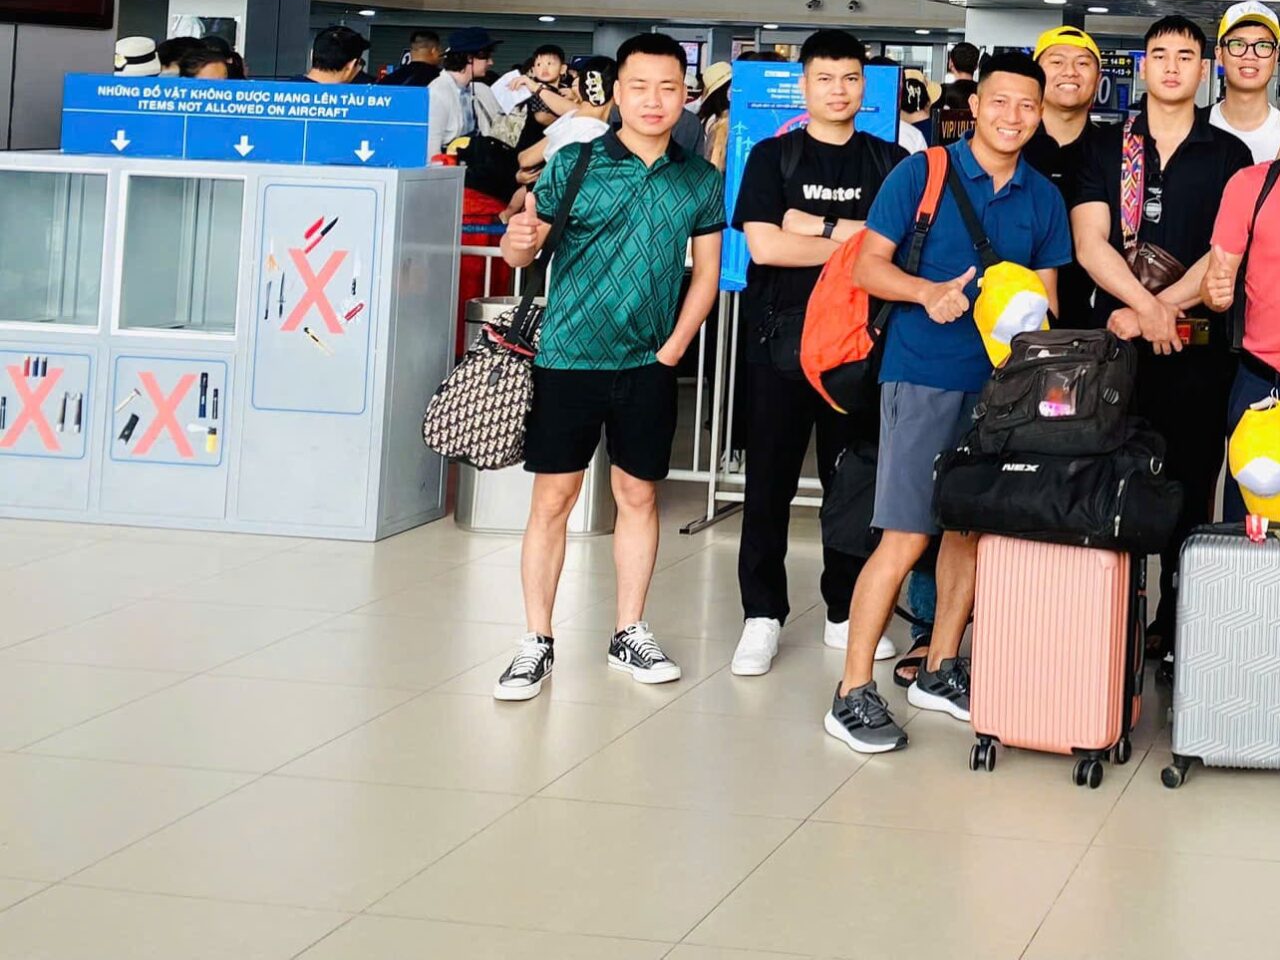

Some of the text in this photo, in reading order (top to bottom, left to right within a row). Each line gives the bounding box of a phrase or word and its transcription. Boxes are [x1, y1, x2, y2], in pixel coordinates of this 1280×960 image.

[97, 84, 140, 97] NHỮNG
[164, 87, 187, 100] VẬT
[190, 87, 232, 101] KHÔNG
[235, 90, 270, 104] ĐƯỢC
[274, 92, 310, 104] MANG
[314, 92, 337, 105] LÊN
[340, 93, 365, 106] TÀU
[367, 95, 392, 107] BAY
[138, 100, 349, 118] ITEMS NOT ALLOWED ON AIRCRAFT
